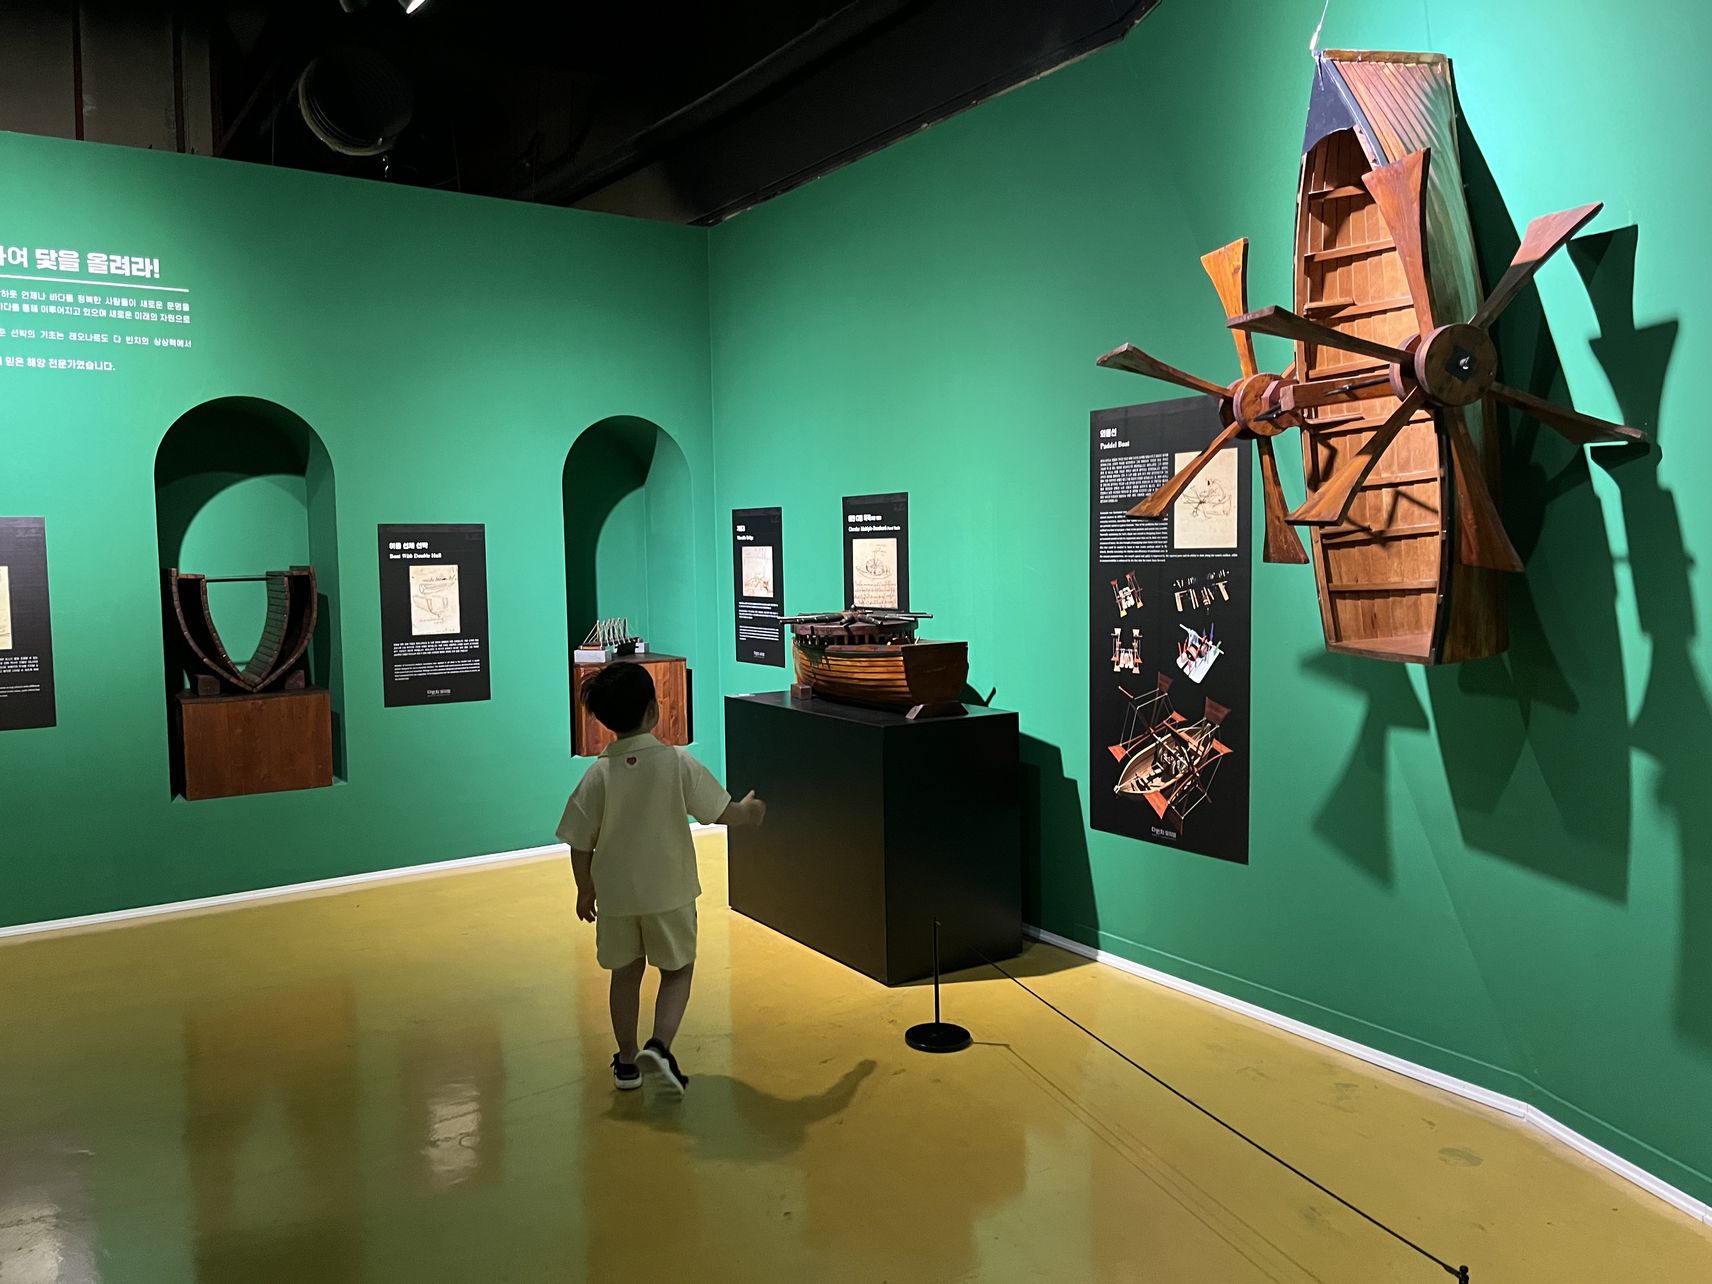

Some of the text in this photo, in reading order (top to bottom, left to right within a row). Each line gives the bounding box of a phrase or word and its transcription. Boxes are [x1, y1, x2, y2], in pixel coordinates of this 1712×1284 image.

[35, 249, 80, 272] 닻을
[86, 253, 160, 278] 올려라!
[0, 290, 17, 298] 하듯
[22, 291, 45, 300] 언제나
[50, 293, 73, 302] 바다를
[106, 297, 136, 306] 사람들이
[141, 300, 163, 309] 새로운
[41, 306, 80, 316] 이루어지고
[110, 311, 132, 321] 새로운
[135, 313, 157, 322] 미래의
[11, 329, 35, 338] 선박의
[41, 331, 64, 340] 기초는
[69, 333, 109, 343] 레오나르도
[114, 335, 121, 344] 다
[126, 337, 149, 345] 빈치의
[154, 338, 192, 348] 상상력에서
[27, 358, 45, 368] 해양
[49, 359, 116, 370] 전문가였습니다.
